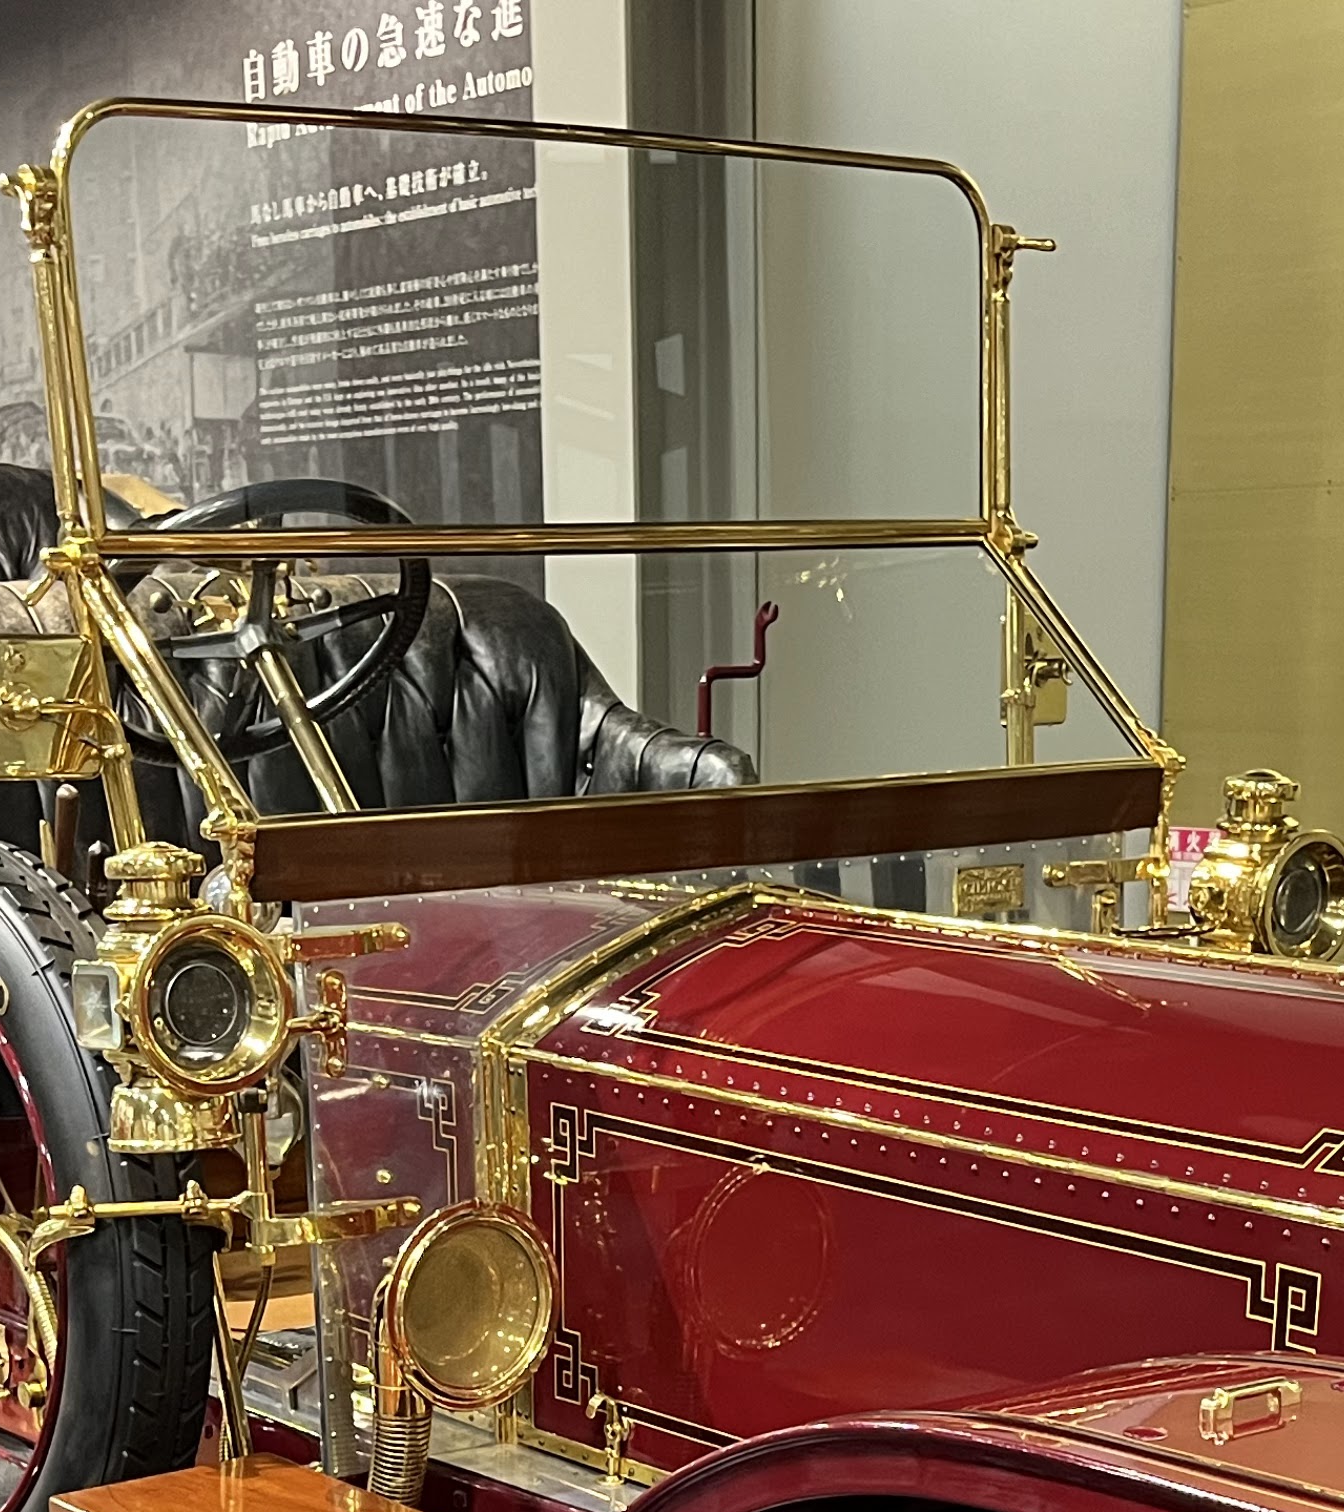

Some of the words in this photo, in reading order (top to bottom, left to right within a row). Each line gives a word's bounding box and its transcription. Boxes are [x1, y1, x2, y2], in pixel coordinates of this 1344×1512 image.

[405, 83, 426, 114] of
[429, 79, 457, 108] the
[462, 66, 533, 101] Automo
